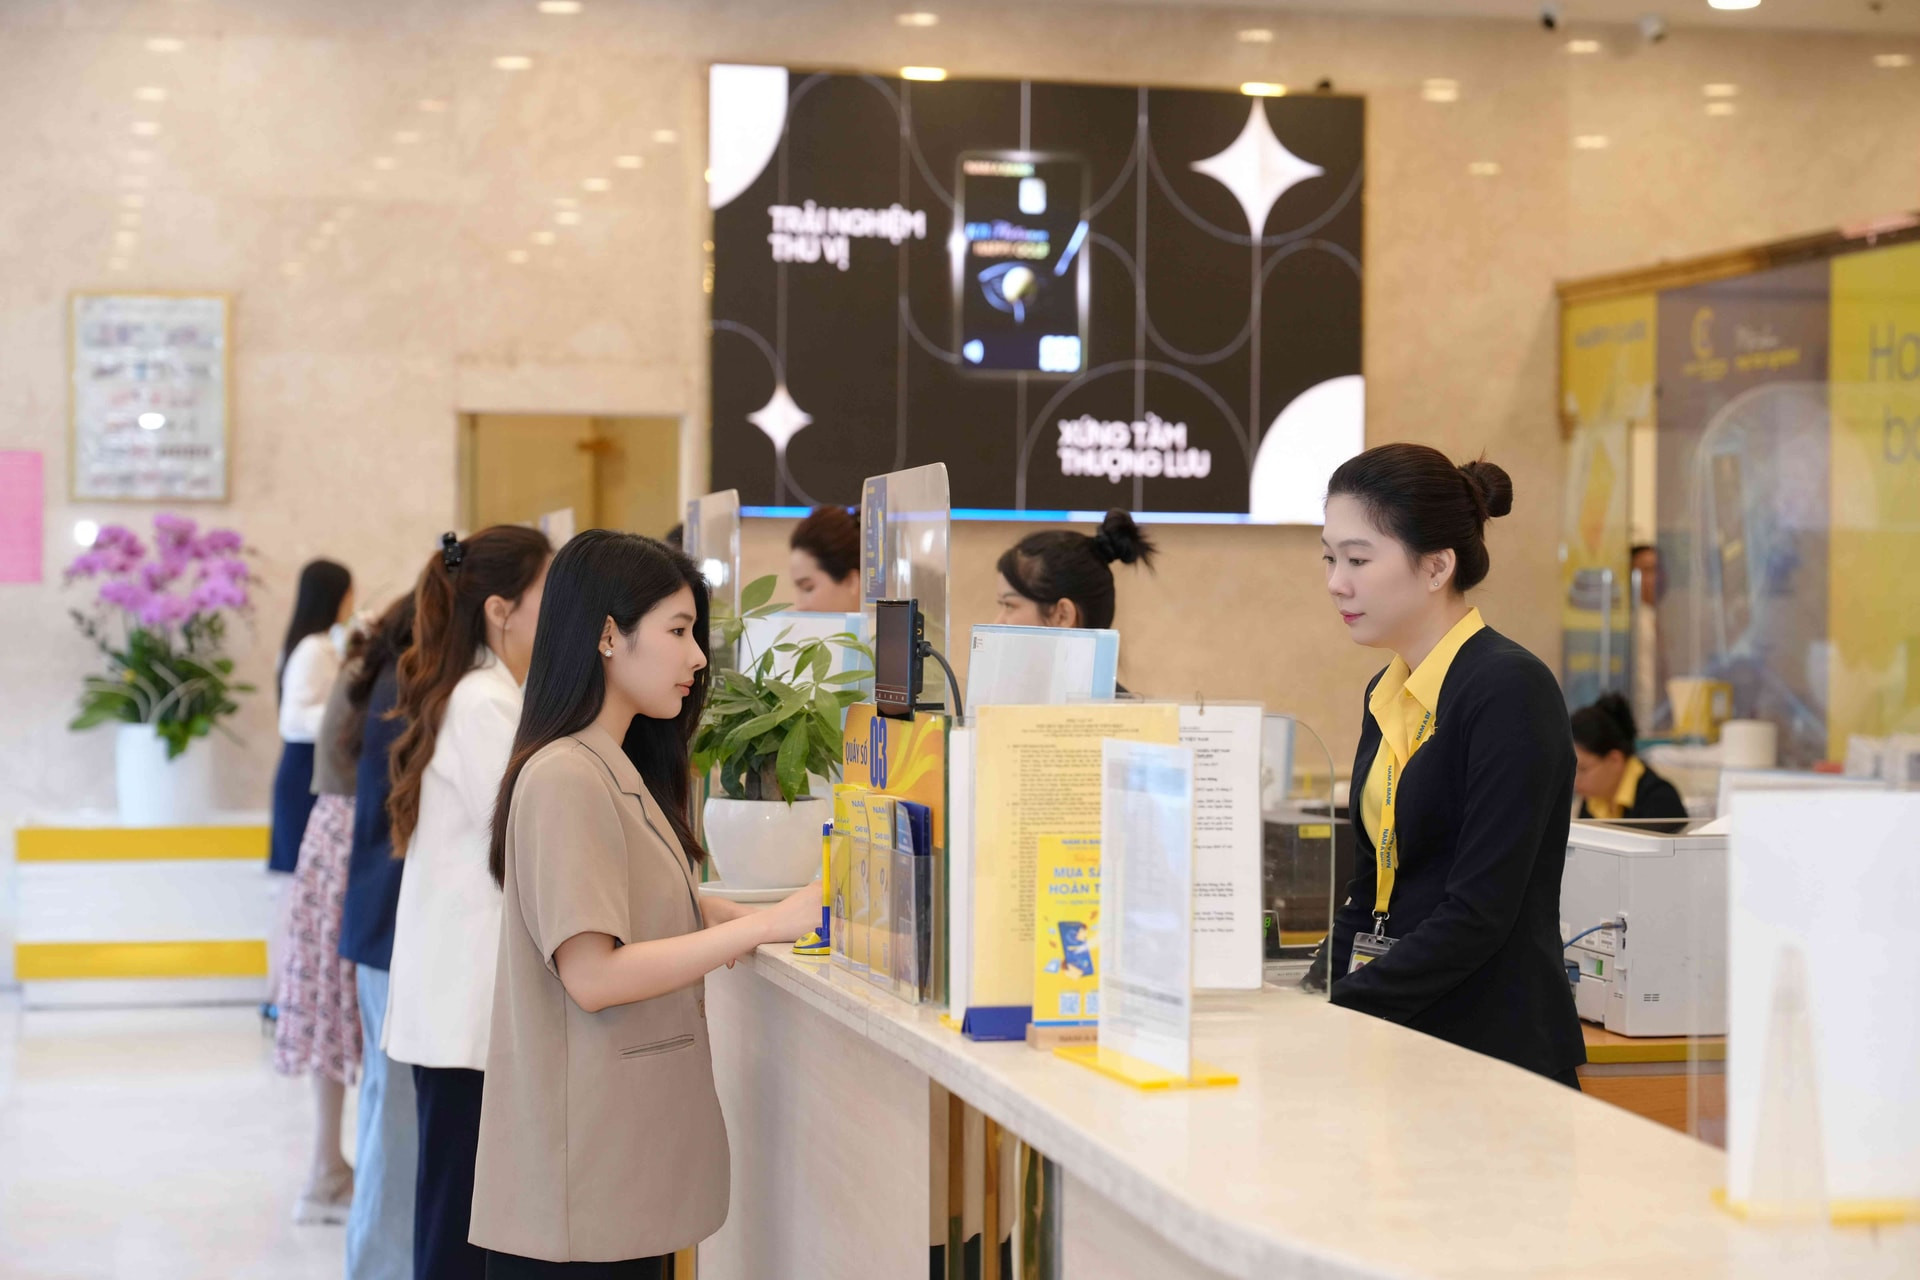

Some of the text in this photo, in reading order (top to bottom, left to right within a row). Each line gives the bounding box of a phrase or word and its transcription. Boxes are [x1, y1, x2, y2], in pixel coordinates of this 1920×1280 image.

[827, 204, 926, 245] NGHIỆM
[870, 716, 887, 789] 03
[1053, 867, 1083, 878] MUA
[1048, 880, 1090, 895] HOÀN
